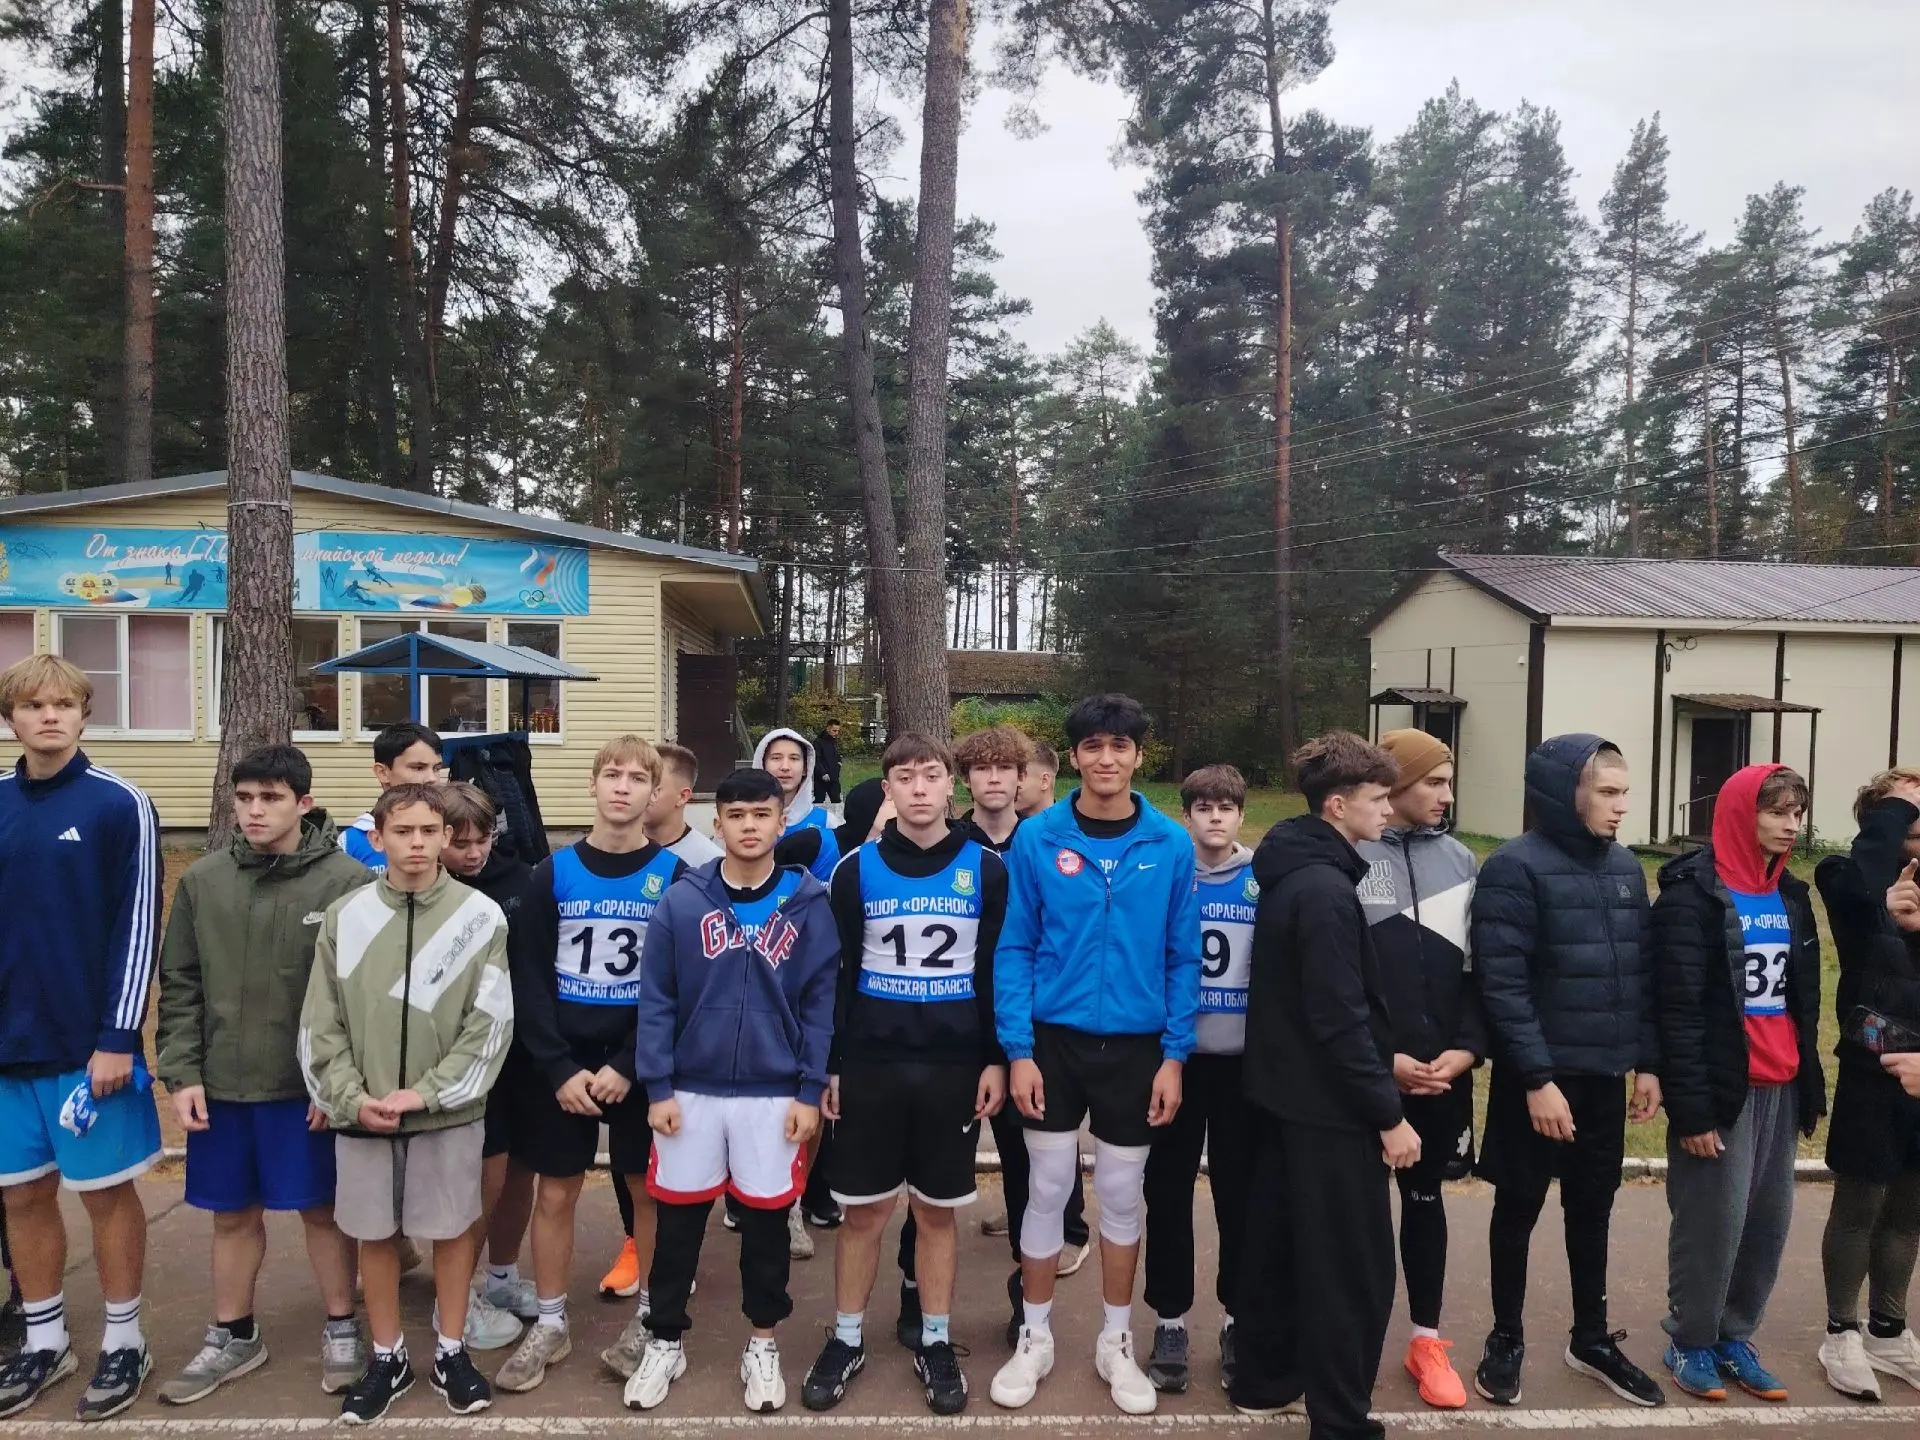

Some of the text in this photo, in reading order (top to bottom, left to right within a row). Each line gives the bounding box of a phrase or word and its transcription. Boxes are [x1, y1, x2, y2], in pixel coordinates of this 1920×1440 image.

[86, 533, 120, 559] От
[122, 543, 182, 563] знака
[392, 542, 471, 569] медали!
[593, 899, 657, 920] «ОРЛЕНОК
[864, 896, 976, 917] СШОР «ОРЛЕНОК»
[441, 911, 491, 967] adidas
[571, 926, 639, 977] 13
[881, 924, 958, 968] 12
[1201, 929, 1231, 979] 9
